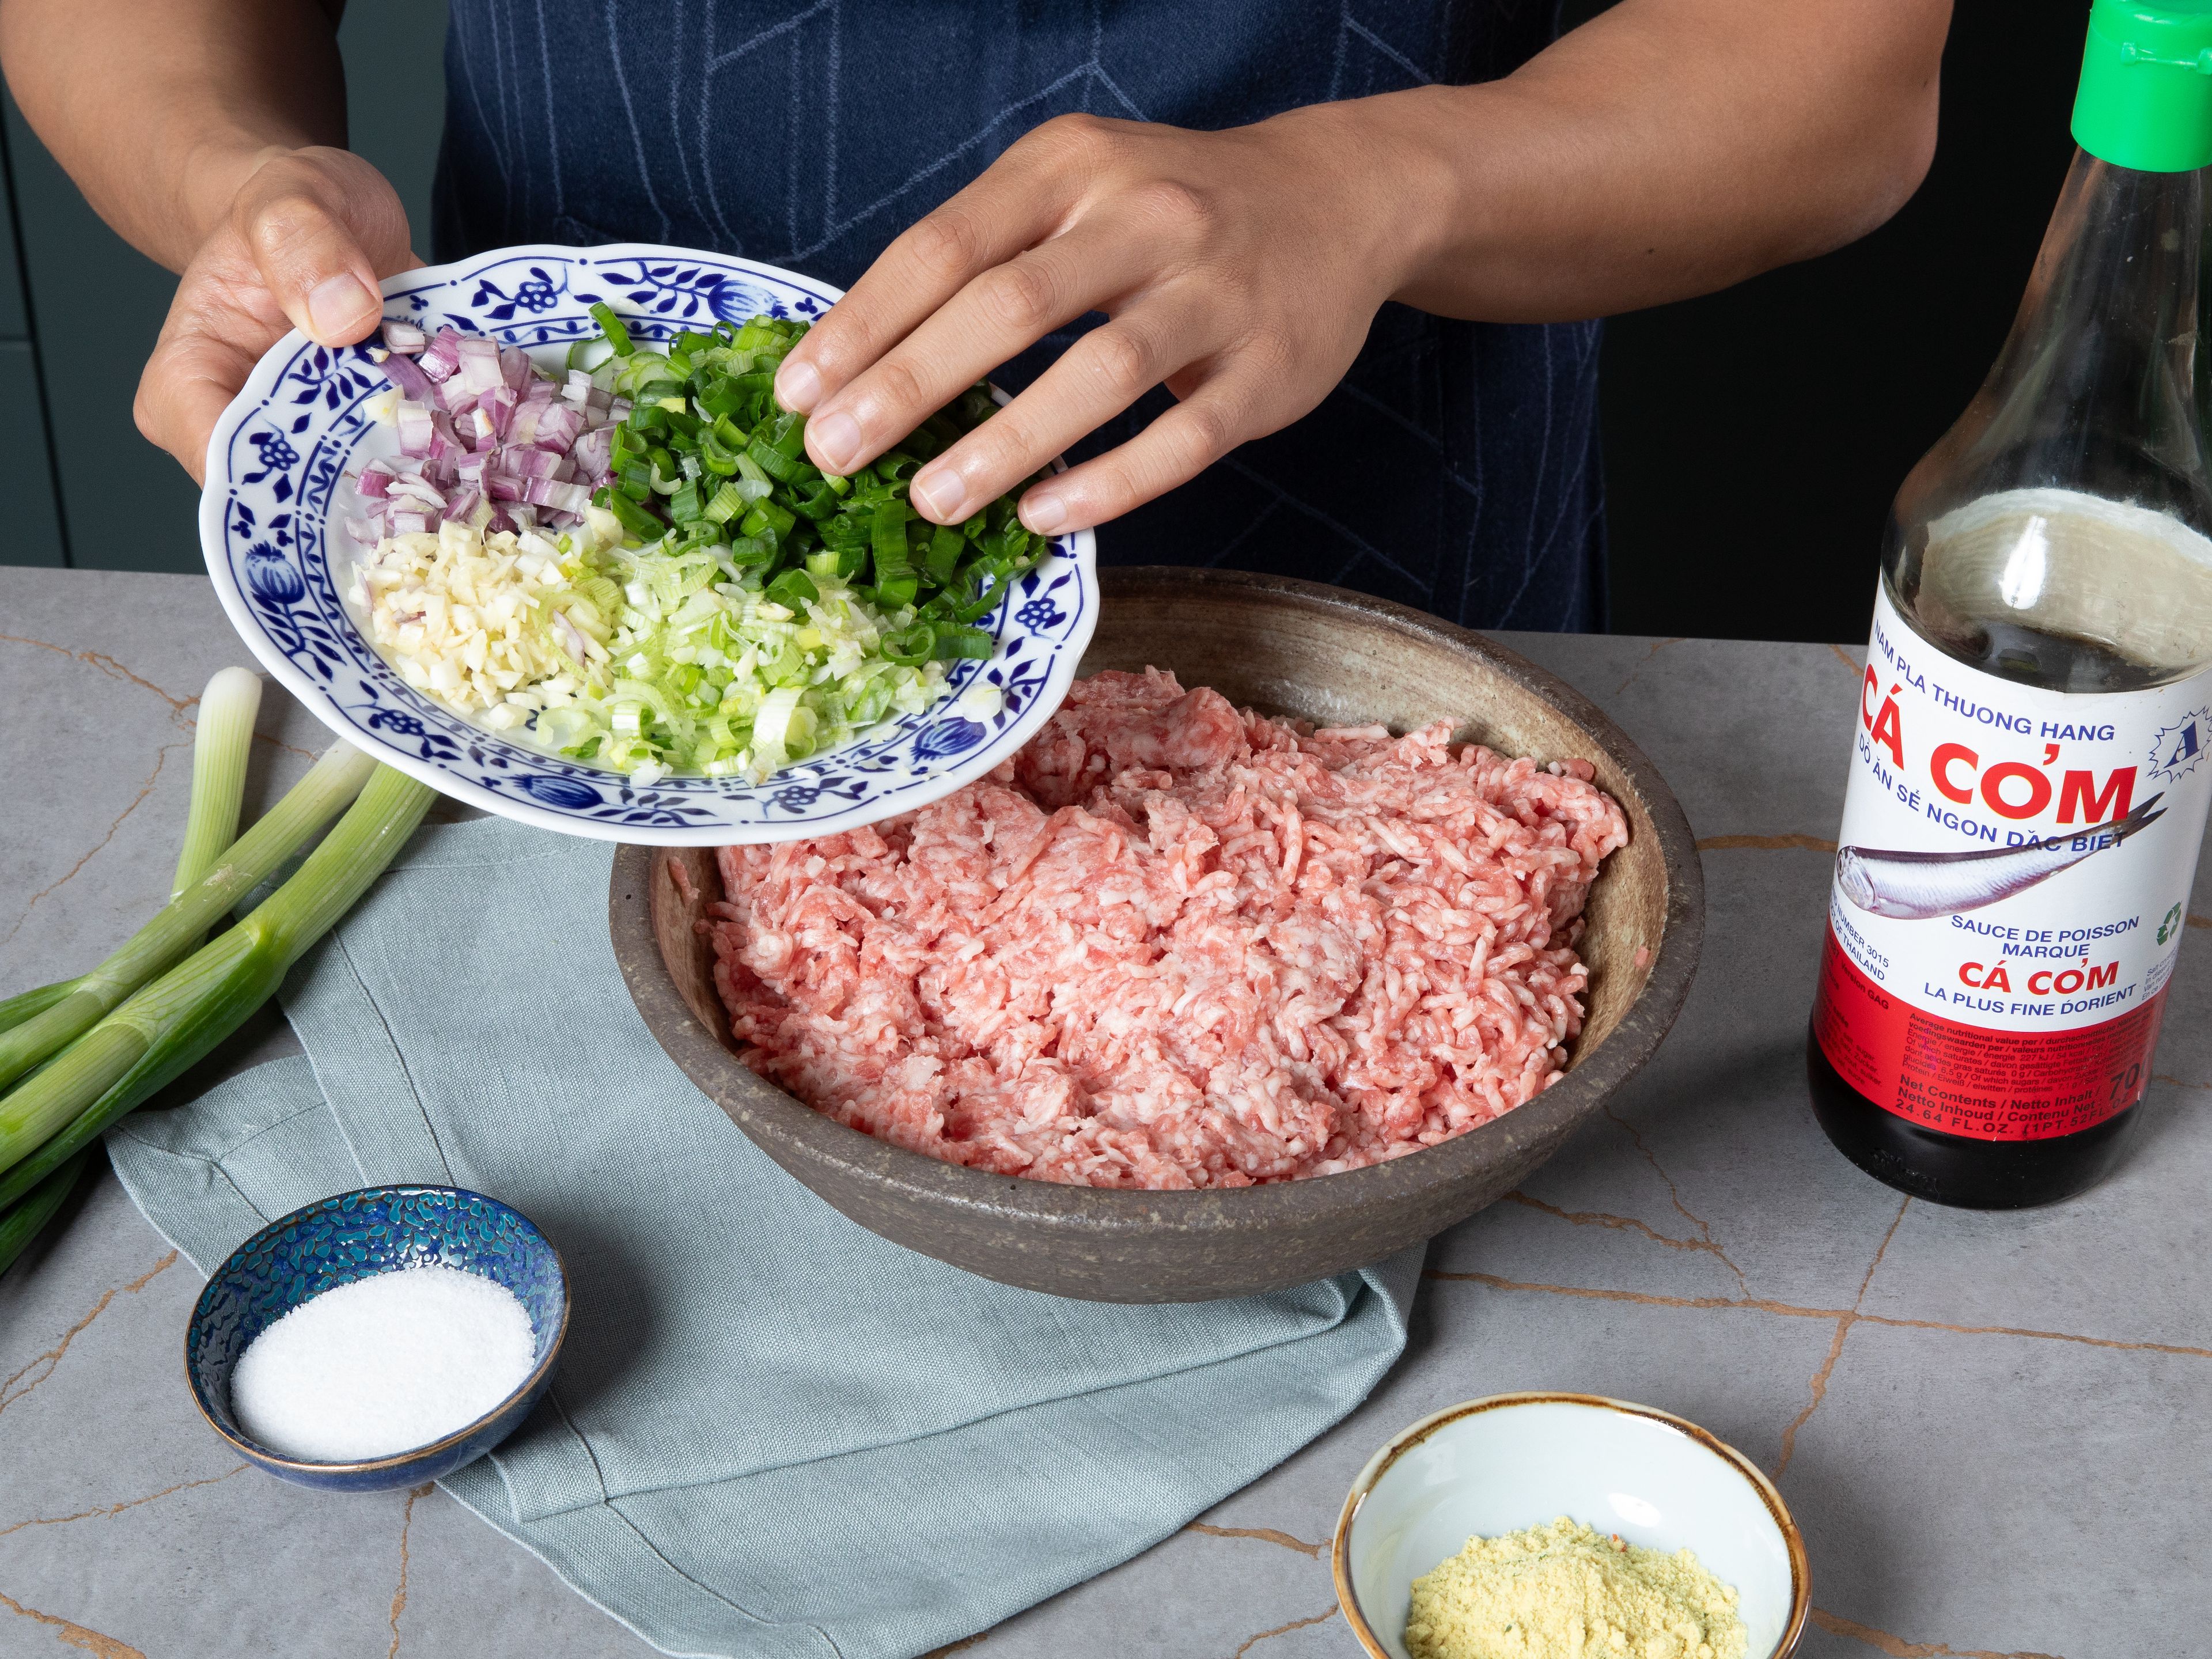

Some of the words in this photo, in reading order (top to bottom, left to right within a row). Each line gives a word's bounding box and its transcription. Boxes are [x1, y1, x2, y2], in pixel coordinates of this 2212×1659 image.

[1876, 619, 1893, 663] NAM
[1897, 656, 1925, 694] PLA
[1933, 683, 2032, 735] THUONG
[2040, 722, 2115, 741] HANG
[1862, 664, 1904, 771] CÁ
[2163, 721, 2200, 768] A
[1927, 803, 1997, 843] NGON
[2071, 831, 2128, 851] BIET
[1837, 904, 1865, 949] NUMBER
[1867, 945, 1889, 968] 3015
[1952, 915, 2019, 940] SAUCE
[2026, 930, 2053, 942] DE
[2059, 916, 2139, 942] POISSON
[1836, 920, 1842, 934] OF
[1843, 933, 1884, 980] THAILAND
[2002, 943, 2090, 958] MARQUE
[1842, 959, 1865, 992] Version
[1868, 990, 1889, 1009] GAG
[1959, 960, 2011, 993] CÁ
[1924, 982, 1946, 1001] LA
[1953, 993, 2004, 1013] PLUS
[2011, 1003, 2055, 1016] FINE
[1907, 1028, 1937, 1045] Energie
[1944, 1044, 1975, 1055] energie
[2069, 1049, 2085, 1057] kcal
[1909, 1021, 1986, 1049] voedingswaarden
[1910, 1013, 1945, 1031] Average
[1947, 1027, 1993, 1042] nutritional
[1995, 1037, 2019, 1045] value
[1903, 1054, 1936, 1070] glucides
[1971, 1073, 1981, 1081] Of
[1983, 1077, 2009, 1085] which
[2011, 1078, 2039, 1086] sugars
[2047, 1075, 2072, 1084] davon
[1905, 1046, 1923, 1056] dont
[1953, 1063, 1972, 1071] gras
[1974, 1067, 2006, 1076] saturés
[1906, 1036, 1916, 1045] Of
[1918, 1043, 1941, 1055] which
[1943, 1052, 1982, 1065] saturates
[2020, 1062, 2061, 1070] gesättigte
[1900, 1074, 1924, 1092] Net
[1927, 1086, 1996, 1108] Contents
[2010, 1099, 2050, 1109] Netto
[2055, 1089, 2092, 1107] Inhalt
[1902, 1060, 1930, 1077] Protein
[1973, 1084, 2006, 1093] eiwitten
[1896, 1098, 1942, 1123] 24.64
[1898, 1086, 1936, 1108] Netto
[1940, 1101, 1994, 1120] Inhoud
[2008, 1110, 2069, 1122] Contenu
[2074, 1101, 2094, 1113] Net
